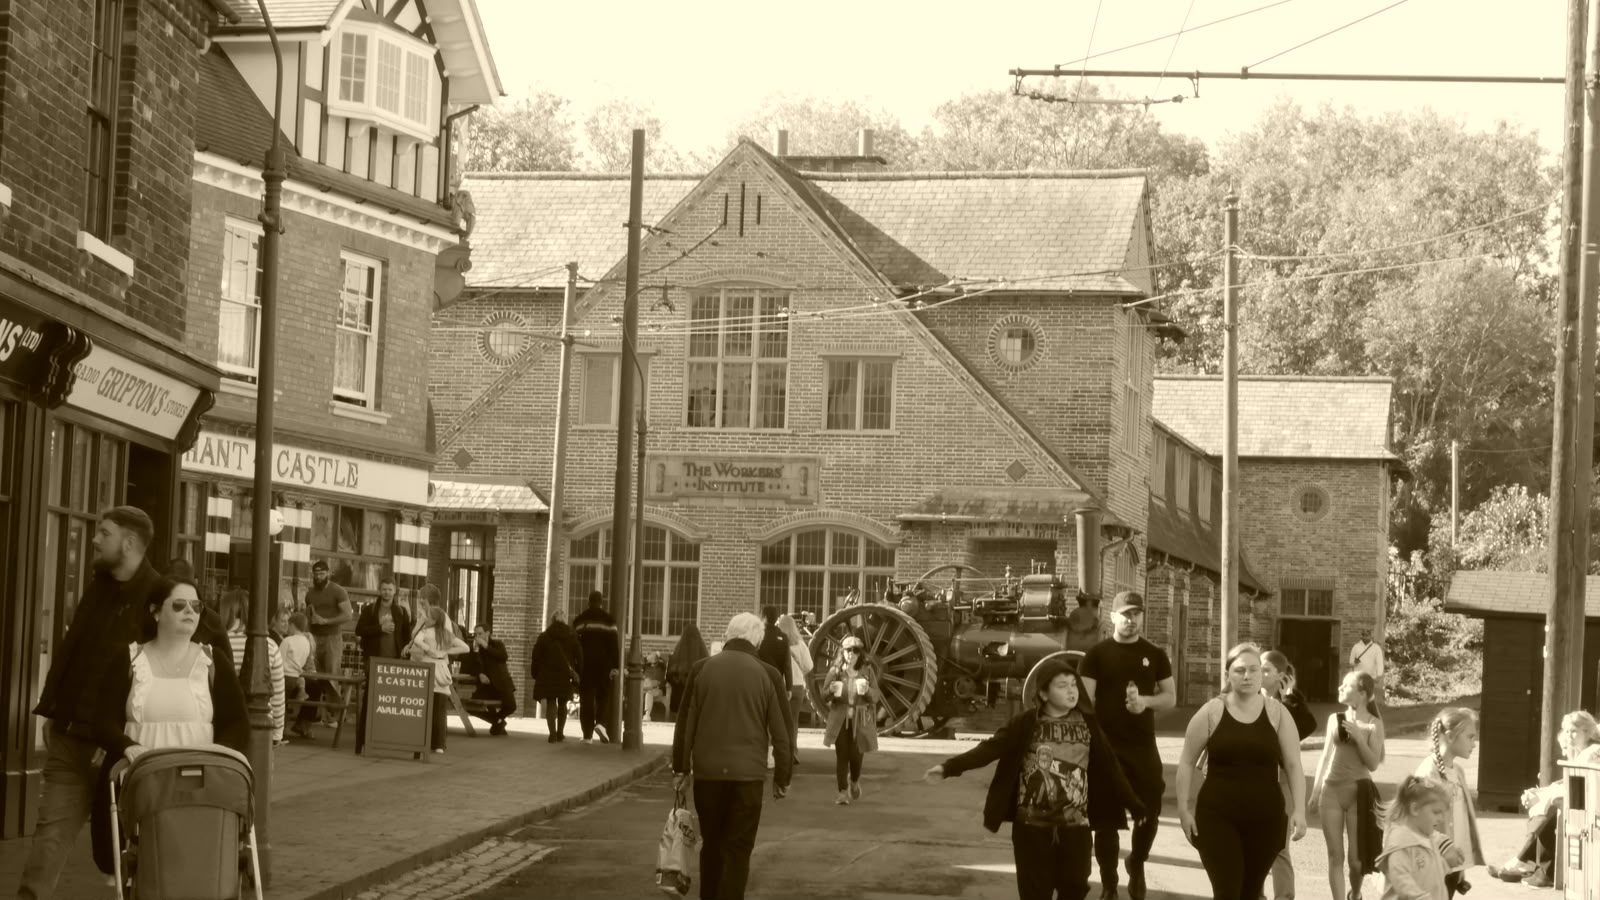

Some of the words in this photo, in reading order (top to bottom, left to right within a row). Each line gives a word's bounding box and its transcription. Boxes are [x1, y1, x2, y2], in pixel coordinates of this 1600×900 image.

[18, 326, 43, 353] (LTD)
[76, 363, 101, 385] RADIO
[163, 399, 189, 419] STORES
[277, 449, 359, 489] CASTLE
[682, 461, 712, 477] THE
[696, 477, 766, 493] INSTITUTE
[377, 664, 429, 677] ELEPHANT
[377, 676, 383, 684] &
[385, 677, 425, 689] CASTLE
[378, 694, 398, 704] HOT
[400, 696, 425, 707] FOOD
[376, 705, 423, 718] AVAILABLE
